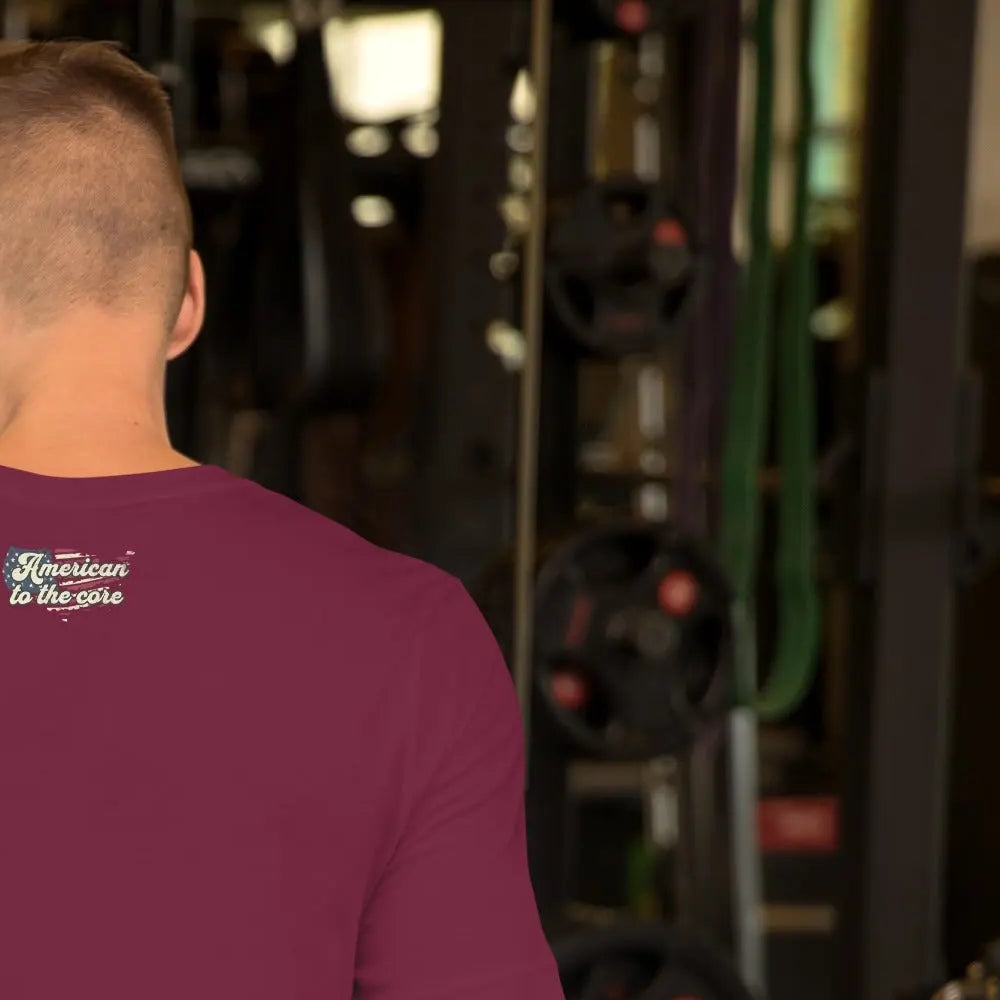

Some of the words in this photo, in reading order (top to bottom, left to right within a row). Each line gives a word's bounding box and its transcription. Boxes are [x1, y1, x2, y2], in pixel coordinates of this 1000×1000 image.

[11, 552, 129, 585] American
[9, 584, 33, 605] to
[36, 584, 72, 605] the
[76, 589, 124, 605] core
